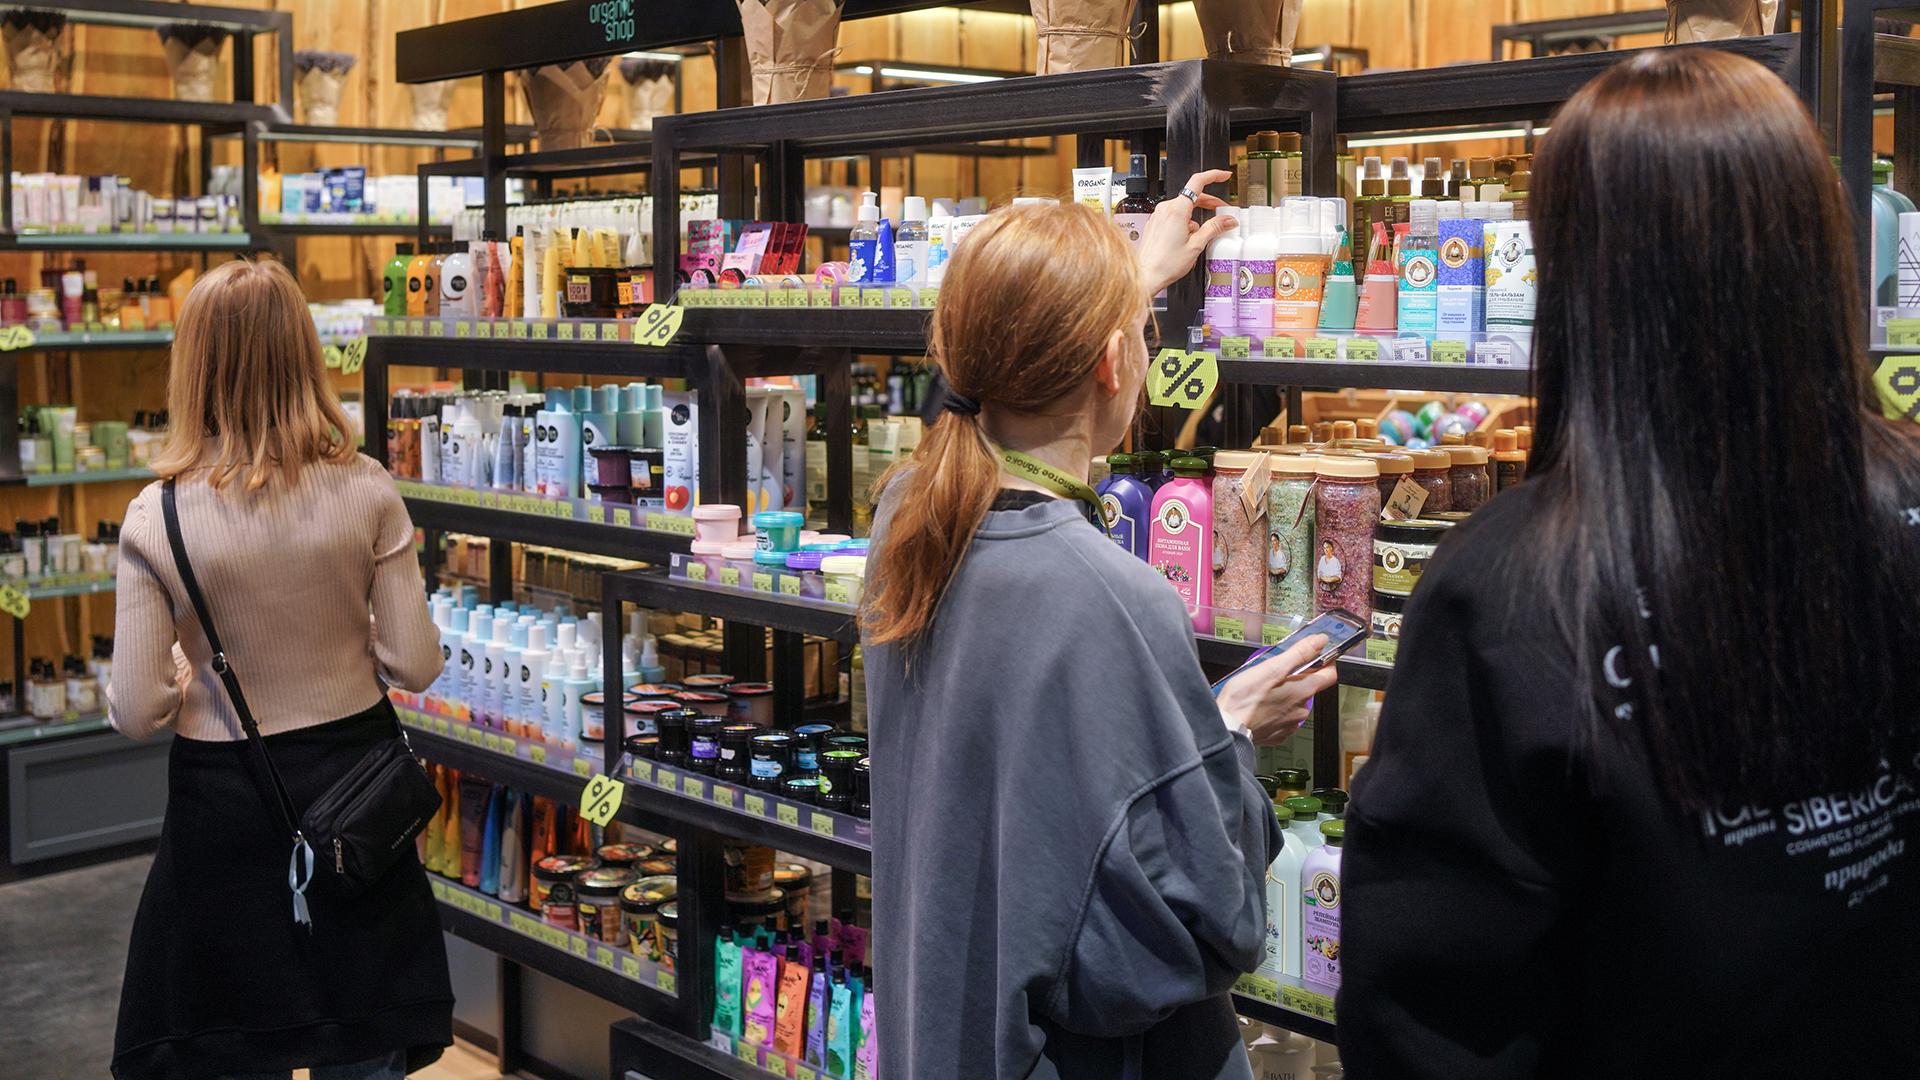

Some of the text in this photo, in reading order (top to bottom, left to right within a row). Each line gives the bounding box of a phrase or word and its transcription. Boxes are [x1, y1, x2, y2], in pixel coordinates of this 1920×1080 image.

[589, 0, 635, 24] organic
[605, 18, 635, 41] shop
[1077, 179, 1107, 188] ORGANIC
